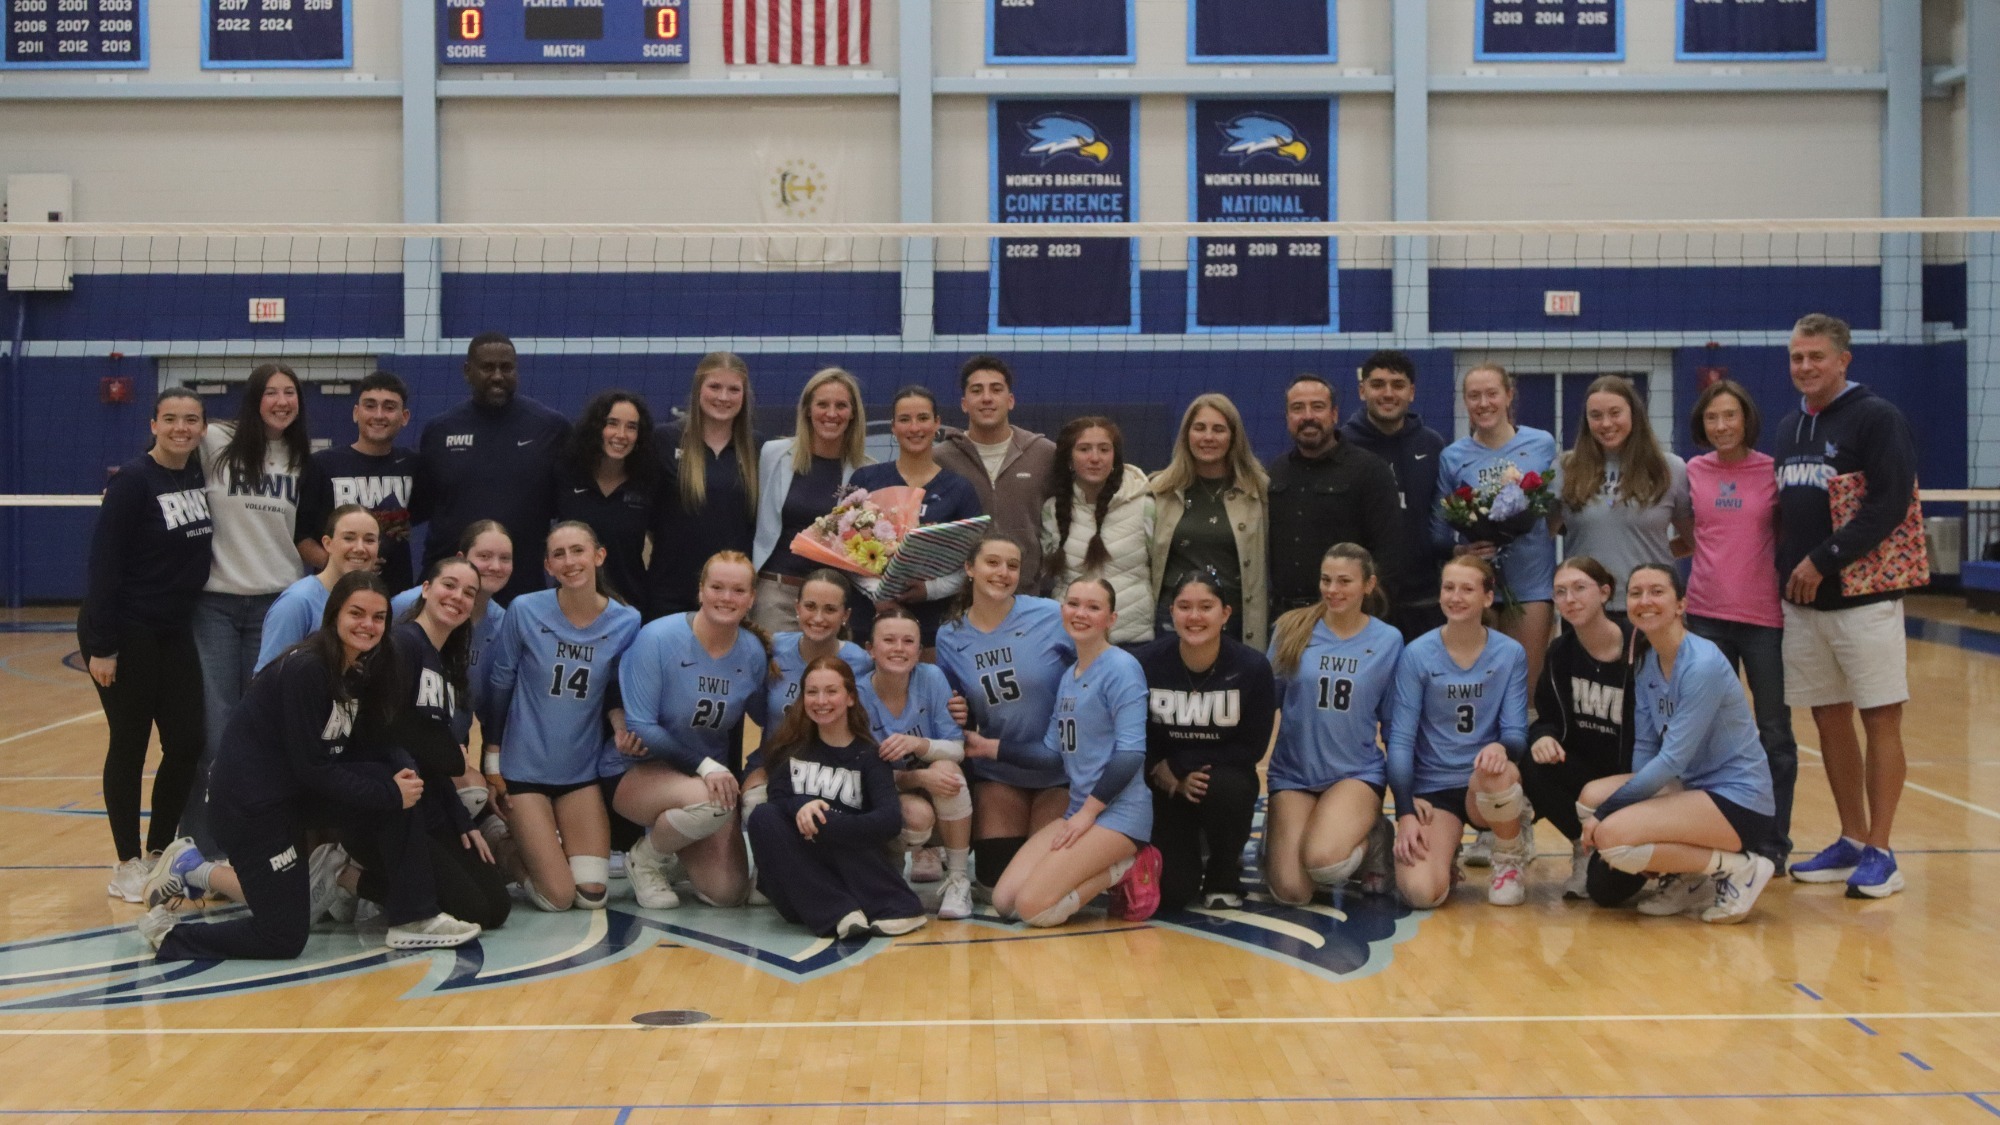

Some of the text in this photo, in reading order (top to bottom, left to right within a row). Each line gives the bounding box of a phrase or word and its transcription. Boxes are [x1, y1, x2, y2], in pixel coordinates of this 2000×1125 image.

[14, 0, 132, 12] 2000 2001 2003
[219, 0, 333, 10] 2017 2018 2019
[14, 20, 133, 33] 2006 2007 2008
[217, 18, 293, 31] 2022 2024
[461, 9, 480, 39] 0
[657, 8, 677, 38] 0
[1493, 11, 1608, 25] 2013 2014 2015
[17, 40, 131, 53] 2011 2012 2013
[446, 45, 486, 58] SCORE
[543, 45, 585, 58] MATCH
[642, 44, 683, 57] SCORE
[1005, 173, 1123, 187] WOMEN'S BASKETBALL
[1204, 173, 1321, 187] WOMEN'S BASKETBALL
[1005, 193, 1123, 212] CONFERENCE
[1221, 194, 1304, 214] NATIONAL
[1006, 244, 1081, 257] 2022 2023
[1206, 243, 1236, 257] 2014
[1288, 243, 1321, 256] 2022
[1205, 263, 1238, 277] 2023
[255, 301, 277, 320] EXIT
[446, 434, 474, 448] RWU
[330, 475, 413, 510] RWU
[156, 487, 211, 531] RW
[556, 641, 595, 663] RWU
[974, 647, 1013, 670] RWU
[1319, 655, 1358, 674] RWU
[549, 662, 591, 700] 14
[698, 676, 730, 695] RWU
[980, 667, 1022, 707] 15
[1316, 676, 1354, 712] 18
[1447, 683, 1484, 699] RWU
[690, 698, 727, 730] 21
[1149, 687, 1241, 727] RWU
[1455, 703, 1476, 734] 3
[1168, 730, 1221, 741] VOLLEYBALL
[789, 756, 863, 810] RWU
